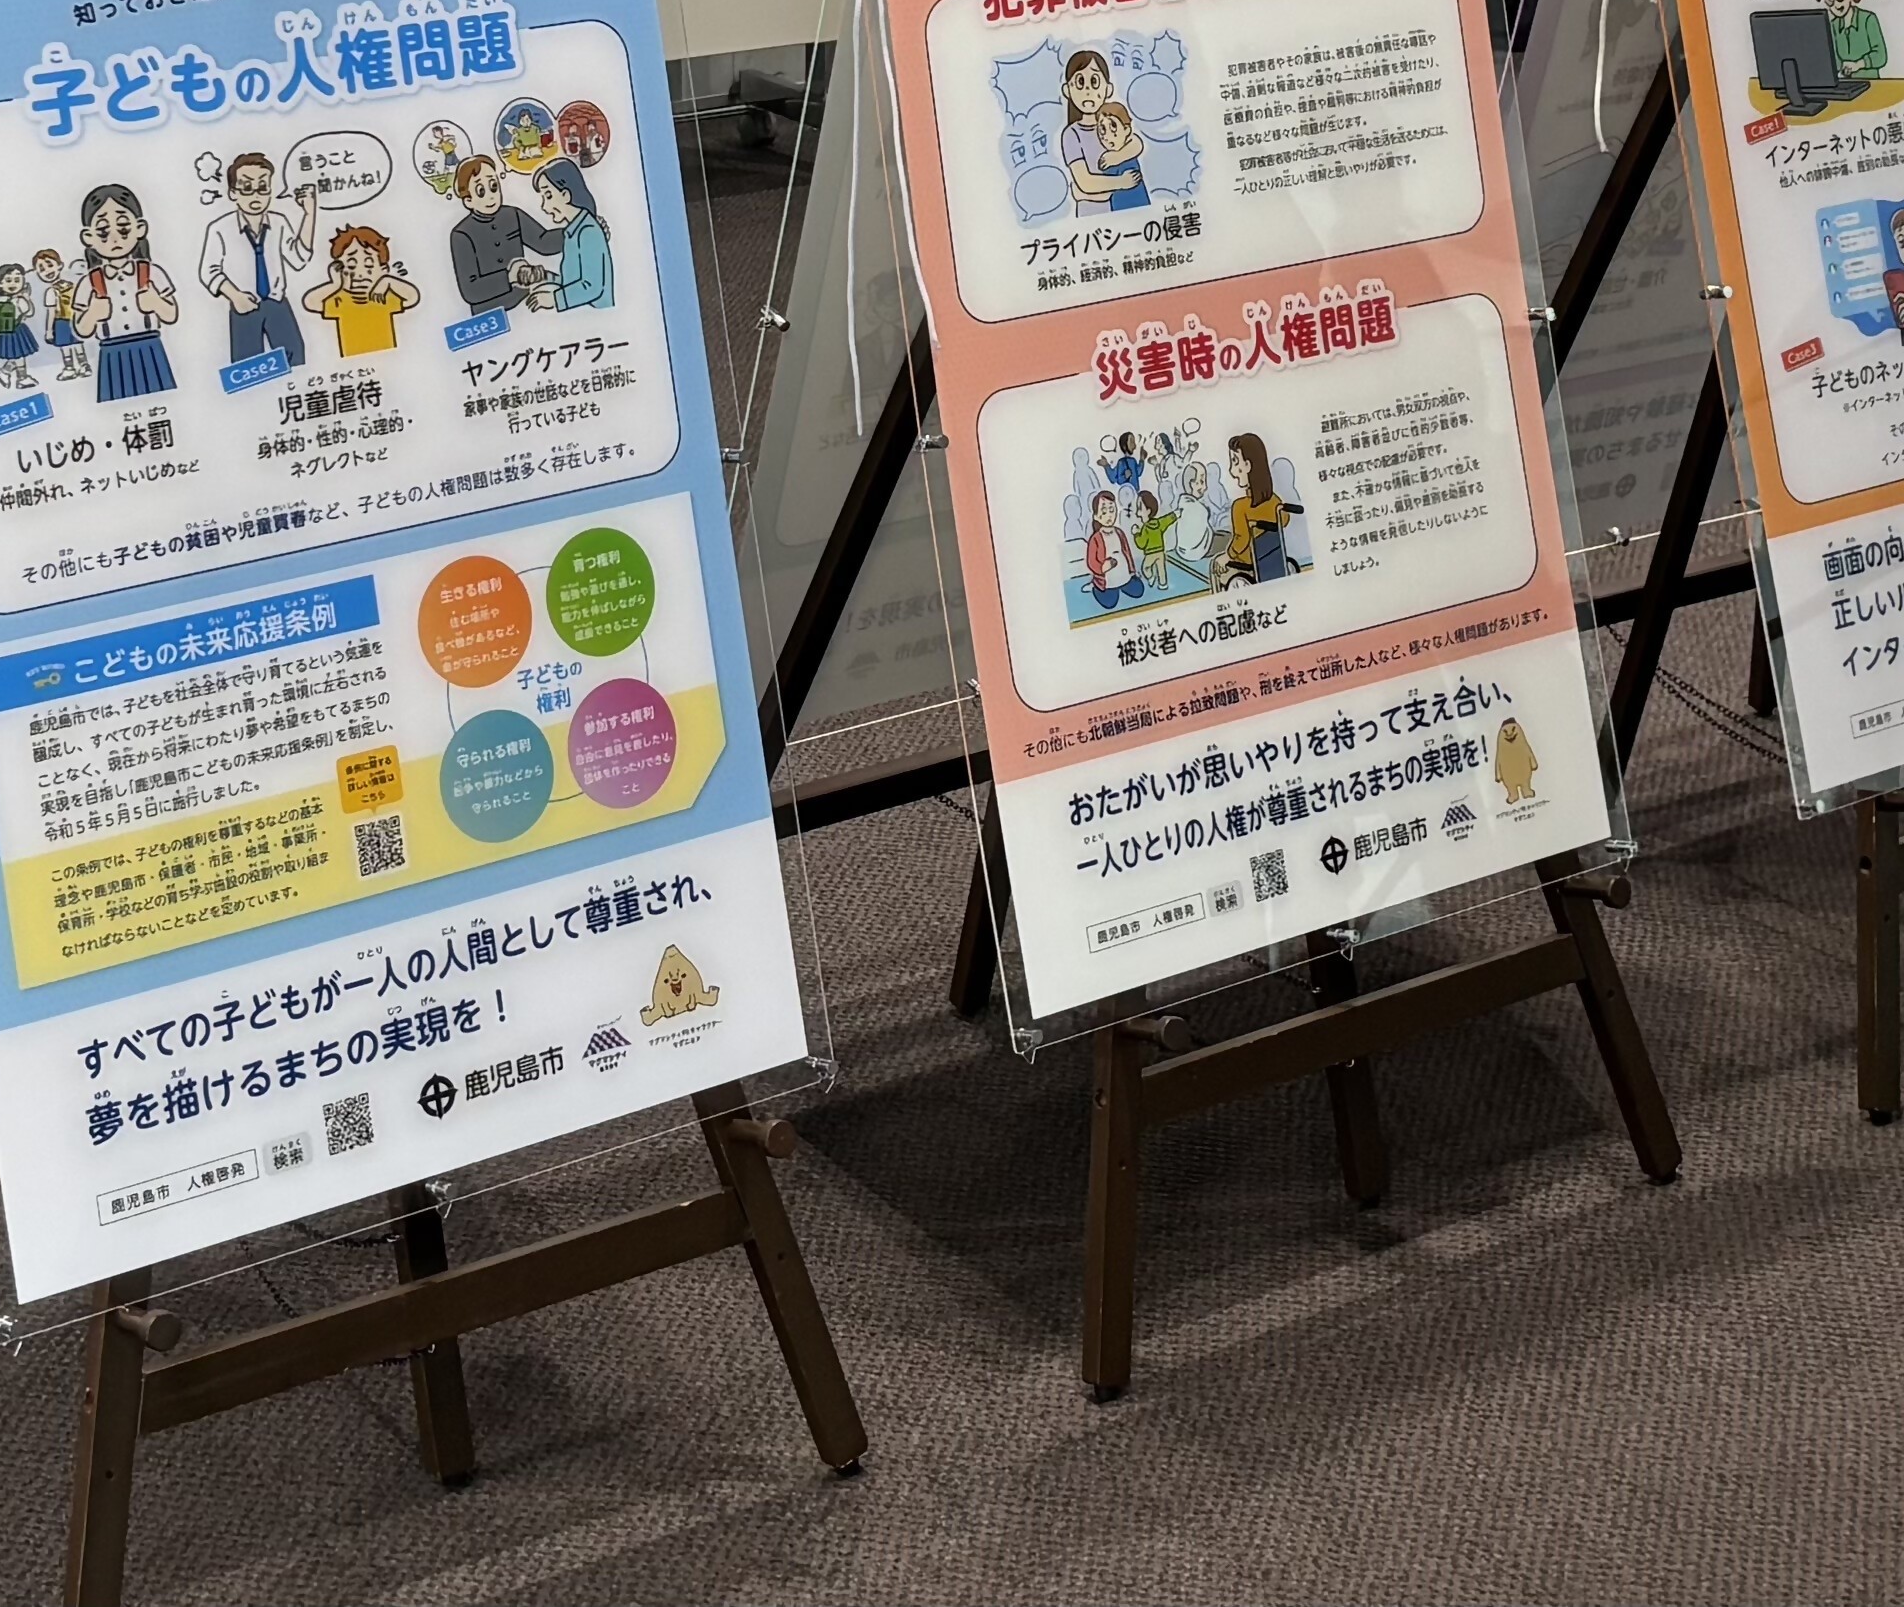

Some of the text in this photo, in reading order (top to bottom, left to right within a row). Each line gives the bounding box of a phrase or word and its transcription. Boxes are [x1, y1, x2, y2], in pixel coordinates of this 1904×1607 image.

[31, 8, 518, 138] 子どもの人権問題
[1750, 119, 1781, 138] Case1
[298, 149, 356, 173] 言うこと
[1021, 213, 1202, 265] プライバシーの侵害
[452, 317, 499, 342] Case3
[461, 339, 629, 387] ヤングケアラー
[1097, 299, 1395, 400] 災害時の人権問題
[228, 358, 281, 386] Case2
[278, 382, 382, 424] 児童虐待
[509, 403, 600, 434] 行っている子ども
[17, 420, 174, 473] いじめ・体罰
[257, 416, 413, 460] 身体的・性的・心理的・
[291, 449, 388, 478] ネグレクトなど
[0, 460, 200, 511] 仲間外れ、ネットいじめなど
[573, 550, 621, 572] 育つ権利
[1334, 556, 1379, 576] しましょう。
[440, 577, 502, 604] 生きる権利
[75, 602, 336, 684] こどもの未来応援条例
[1116, 605, 1288, 666] 被災者への配慮など
[517, 661, 582, 690] 子どもの
[537, 687, 571, 714] 権利
[584, 706, 655, 736] 参加する権利
[456, 739, 532, 768] 守られる権利
[1069, 679, 1512, 827] おたがいが思いやりを持って支え合い、
[360, 791, 386, 804] こちら
[472, 789, 532, 814] 守られること
[622, 782, 640, 794] こと
[1077, 736, 1489, 878] 一人ひとりの人権が尊重されるまちの実現を！
[1355, 817, 1428, 861] 鹿児島市
[1214, 893, 1239, 913] 検索
[78, 884, 713, 1078] すべての子どもが一人の人間として尊重され、
[89, 990, 508, 1146] 夢を描けるまちの実現を！
[467, 1048, 565, 1102] 鹿児島市
[187, 1163, 246, 1193] 人権啓発
[271, 1147, 303, 1167] 検索
